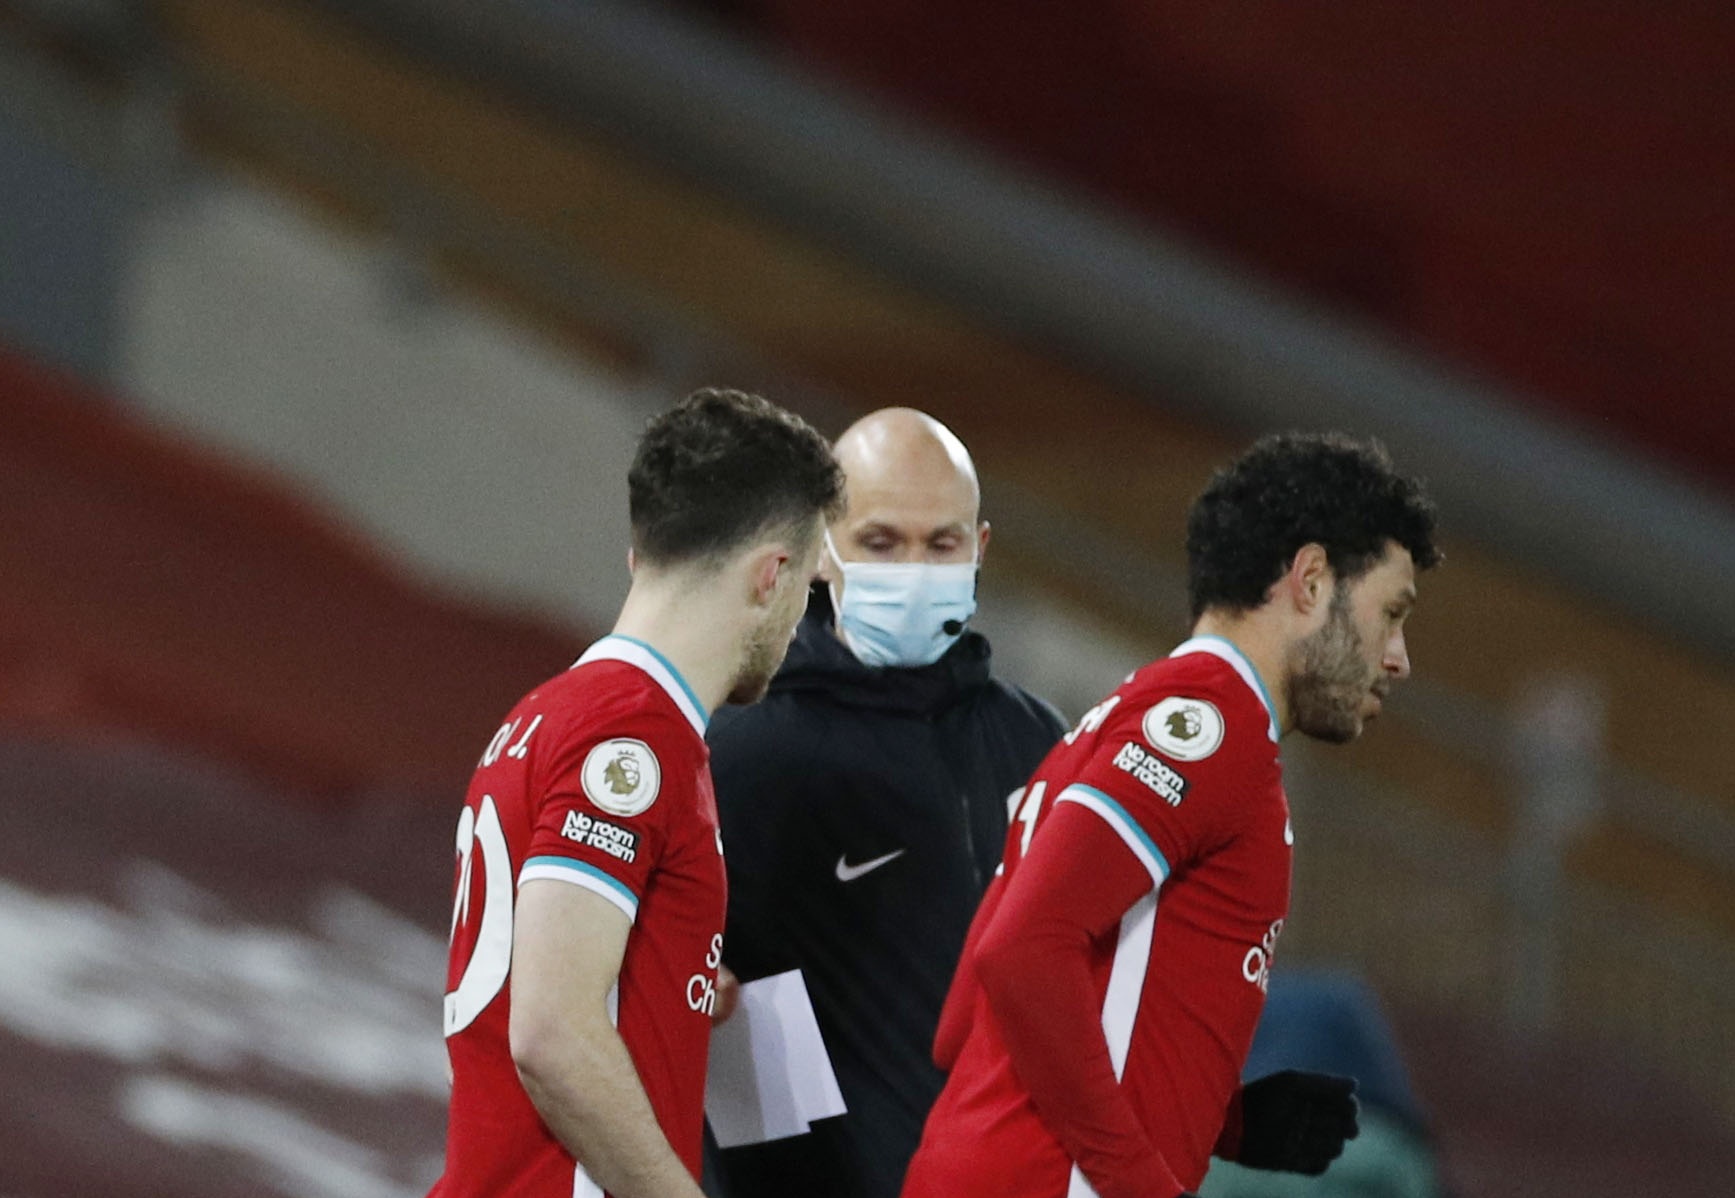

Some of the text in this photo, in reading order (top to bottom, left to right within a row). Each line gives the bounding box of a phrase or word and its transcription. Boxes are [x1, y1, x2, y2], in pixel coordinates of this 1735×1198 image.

[1119, 741, 1185, 792] No room
[561, 822, 588, 843] for
[564, 809, 635, 848] No room
